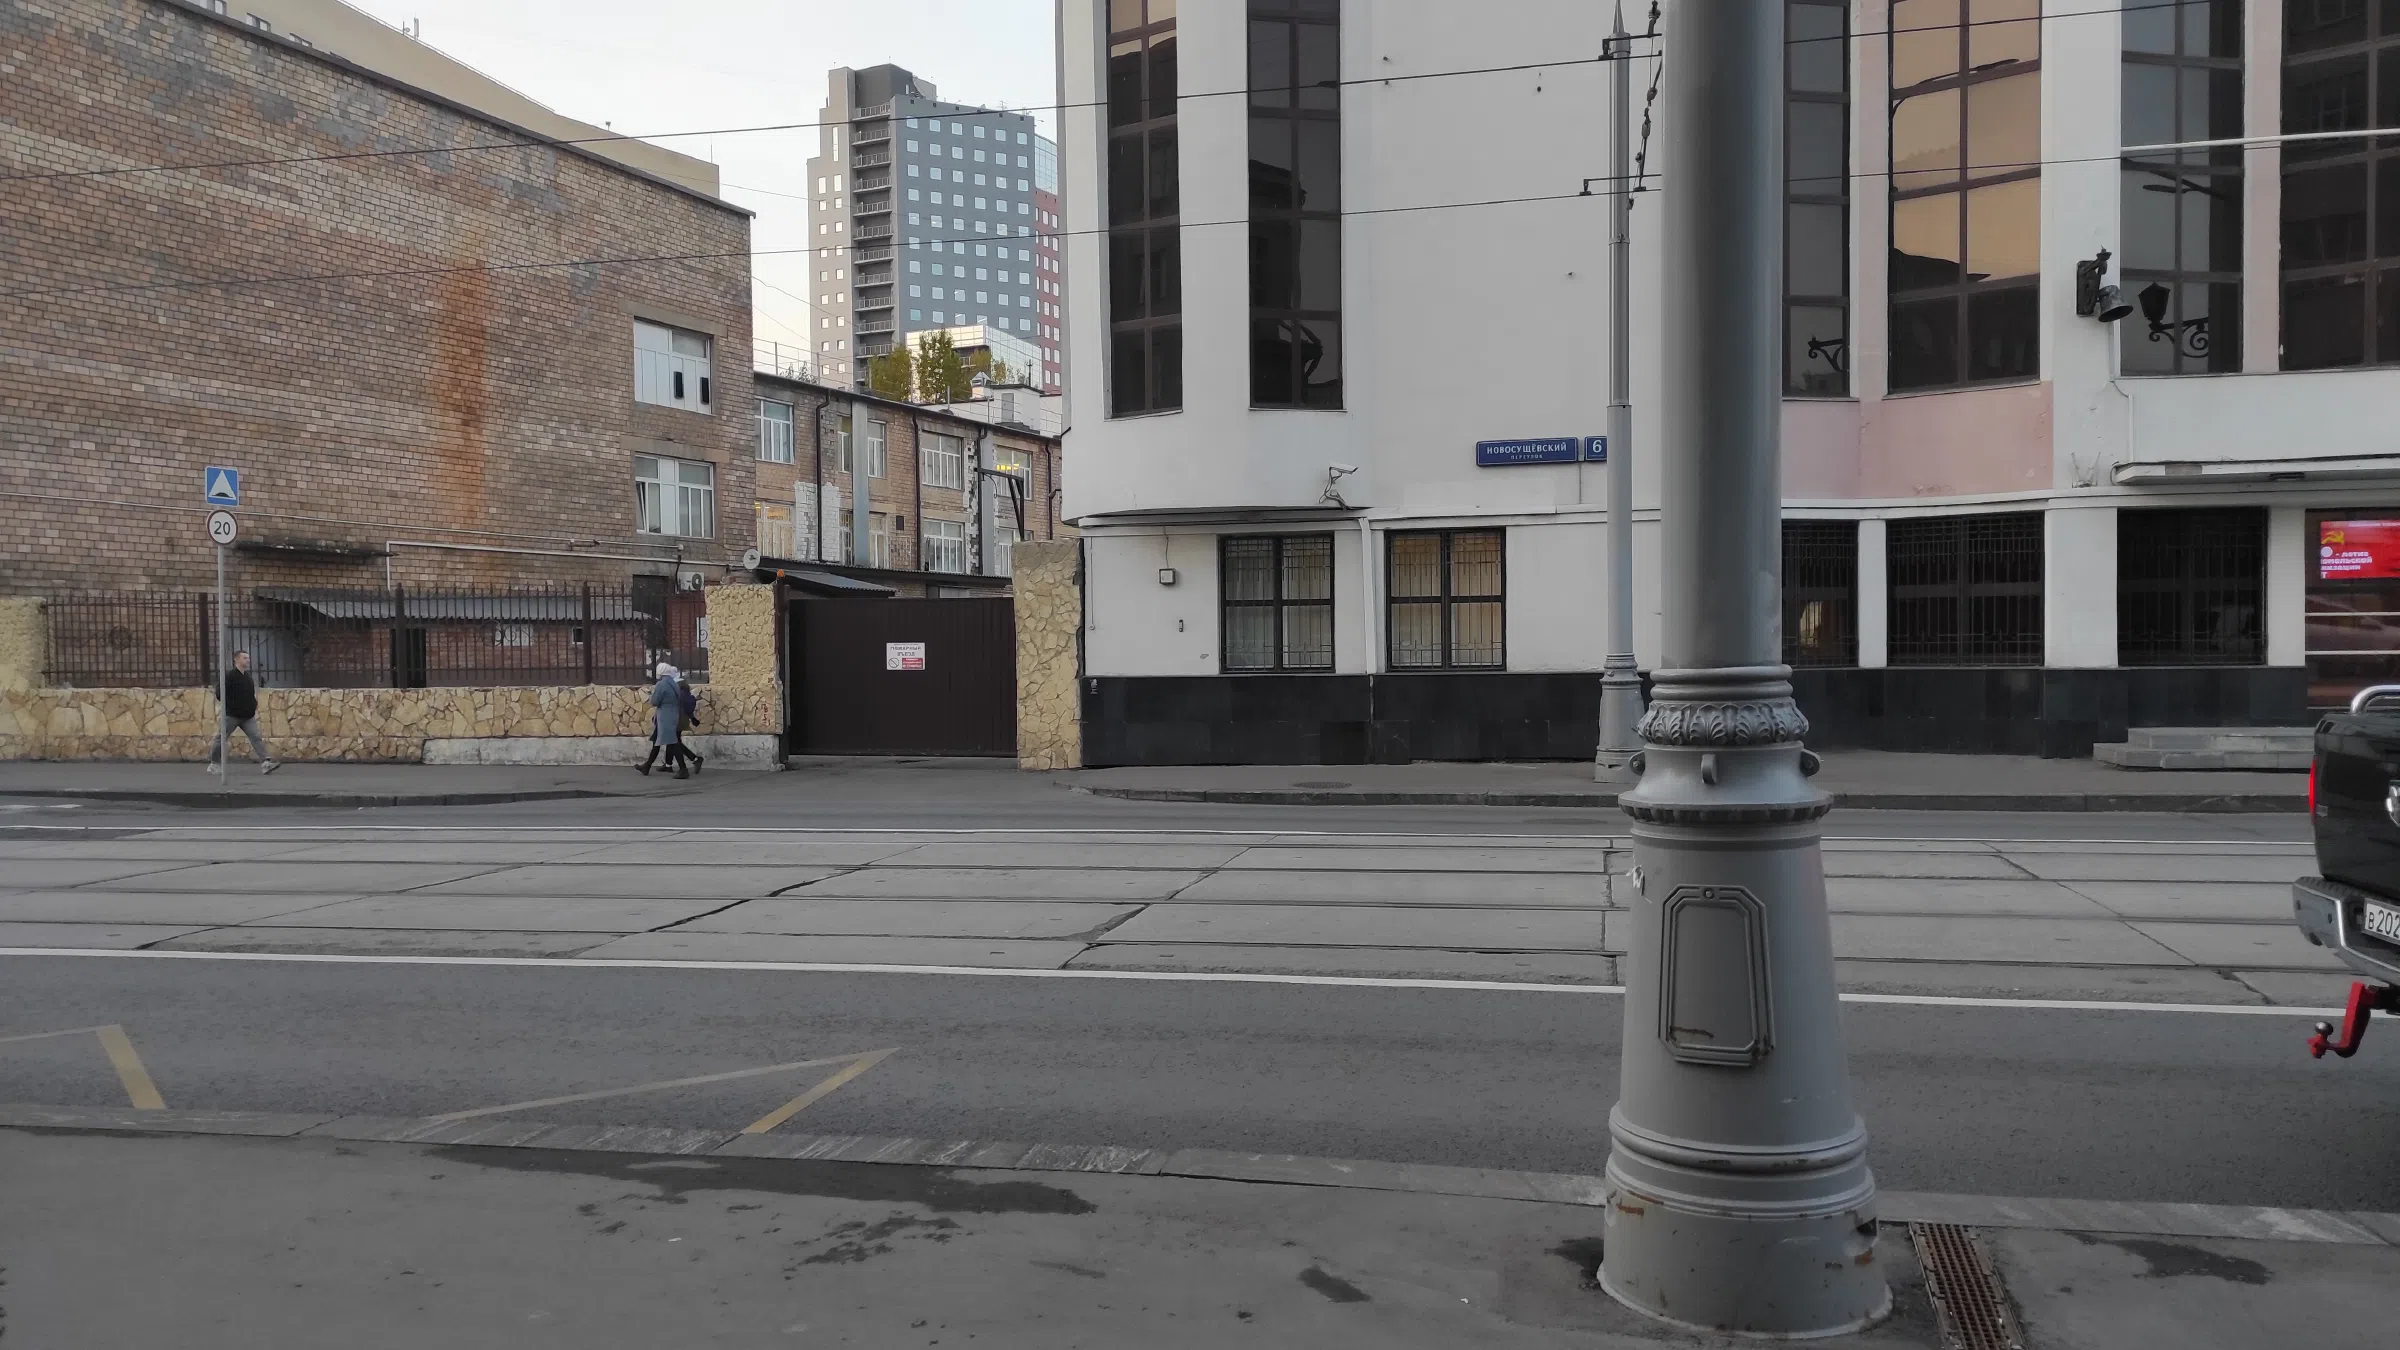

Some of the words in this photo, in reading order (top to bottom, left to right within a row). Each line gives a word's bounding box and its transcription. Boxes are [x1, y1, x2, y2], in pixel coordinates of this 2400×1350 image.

[1486, 442, 1568, 454] НОВОСУЩЁВСКИЙ
[1592, 440, 1602, 452] 6
[214, 520, 230, 536] 20
